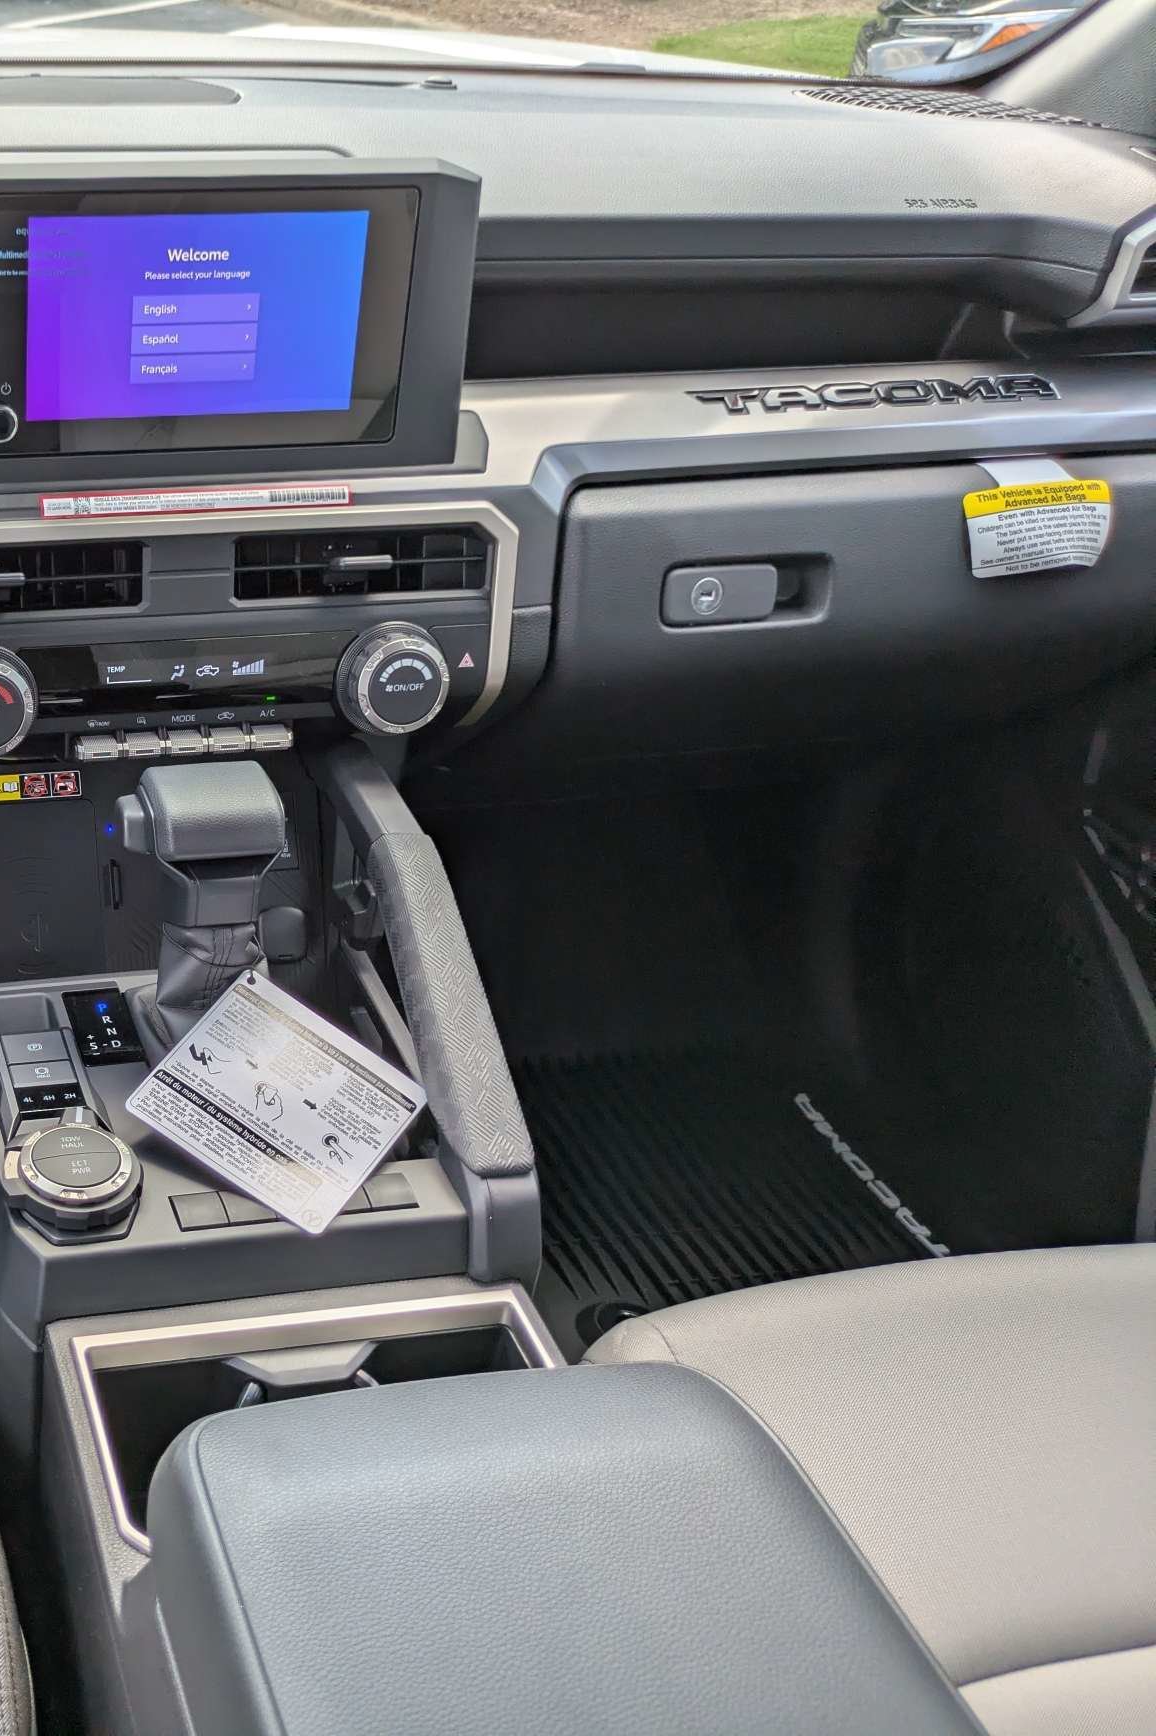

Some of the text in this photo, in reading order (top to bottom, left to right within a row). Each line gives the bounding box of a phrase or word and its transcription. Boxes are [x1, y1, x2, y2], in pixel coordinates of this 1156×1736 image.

[167, 248, 230, 262] Welcome
[144, 269, 251, 281] Please select your language
[144, 304, 177, 317] English
[142, 334, 179, 346] Español
[141, 364, 178, 376] Français
[684, 374, 1061, 416] TACOMA
[976, 493, 998, 502] This
[999, 488, 1033, 499] Vehicle
[1042, 479, 1084, 497] Equipped
[1005, 491, 1086, 508] Advanced Air Bags
[997, 513, 1018, 521] Even
[1037, 503, 1070, 515] Advanced
[1081, 502, 1096, 511] Bags
[977, 524, 1003, 534] Children
[1009, 528, 1023, 536] back
[997, 538, 1015, 546] Never
[1032, 531, 1062, 539] rear-facing
[1003, 545, 1025, 553] Always
[994, 554, 1020, 563] owner's
[1021, 549, 1044, 558] manual
[1041, 556, 1070, 566] removed
[107, 665, 126, 674] TEMP
[393, 683, 425, 693] ON/OFF
[171, 714, 196, 724] MODE
[259, 708, 276, 718] A/C
[99, 1003, 108, 1014] P
[102, 1015, 113, 1024] R
[107, 1027, 118, 1036] N
[90, 1039, 122, 1051] S D
[23, 1092, 77, 1104] 4L 4H 2H
[156, 1071, 174, 1085] Arrêt
[172, 1082, 182, 1090] du
[181, 1088, 204, 1105] moteur
[207, 1106, 217, 1114] du
[216, 1112, 242, 1133] système
[242, 1129, 266, 1150] hybride
[266, 1148, 275, 1157] en
